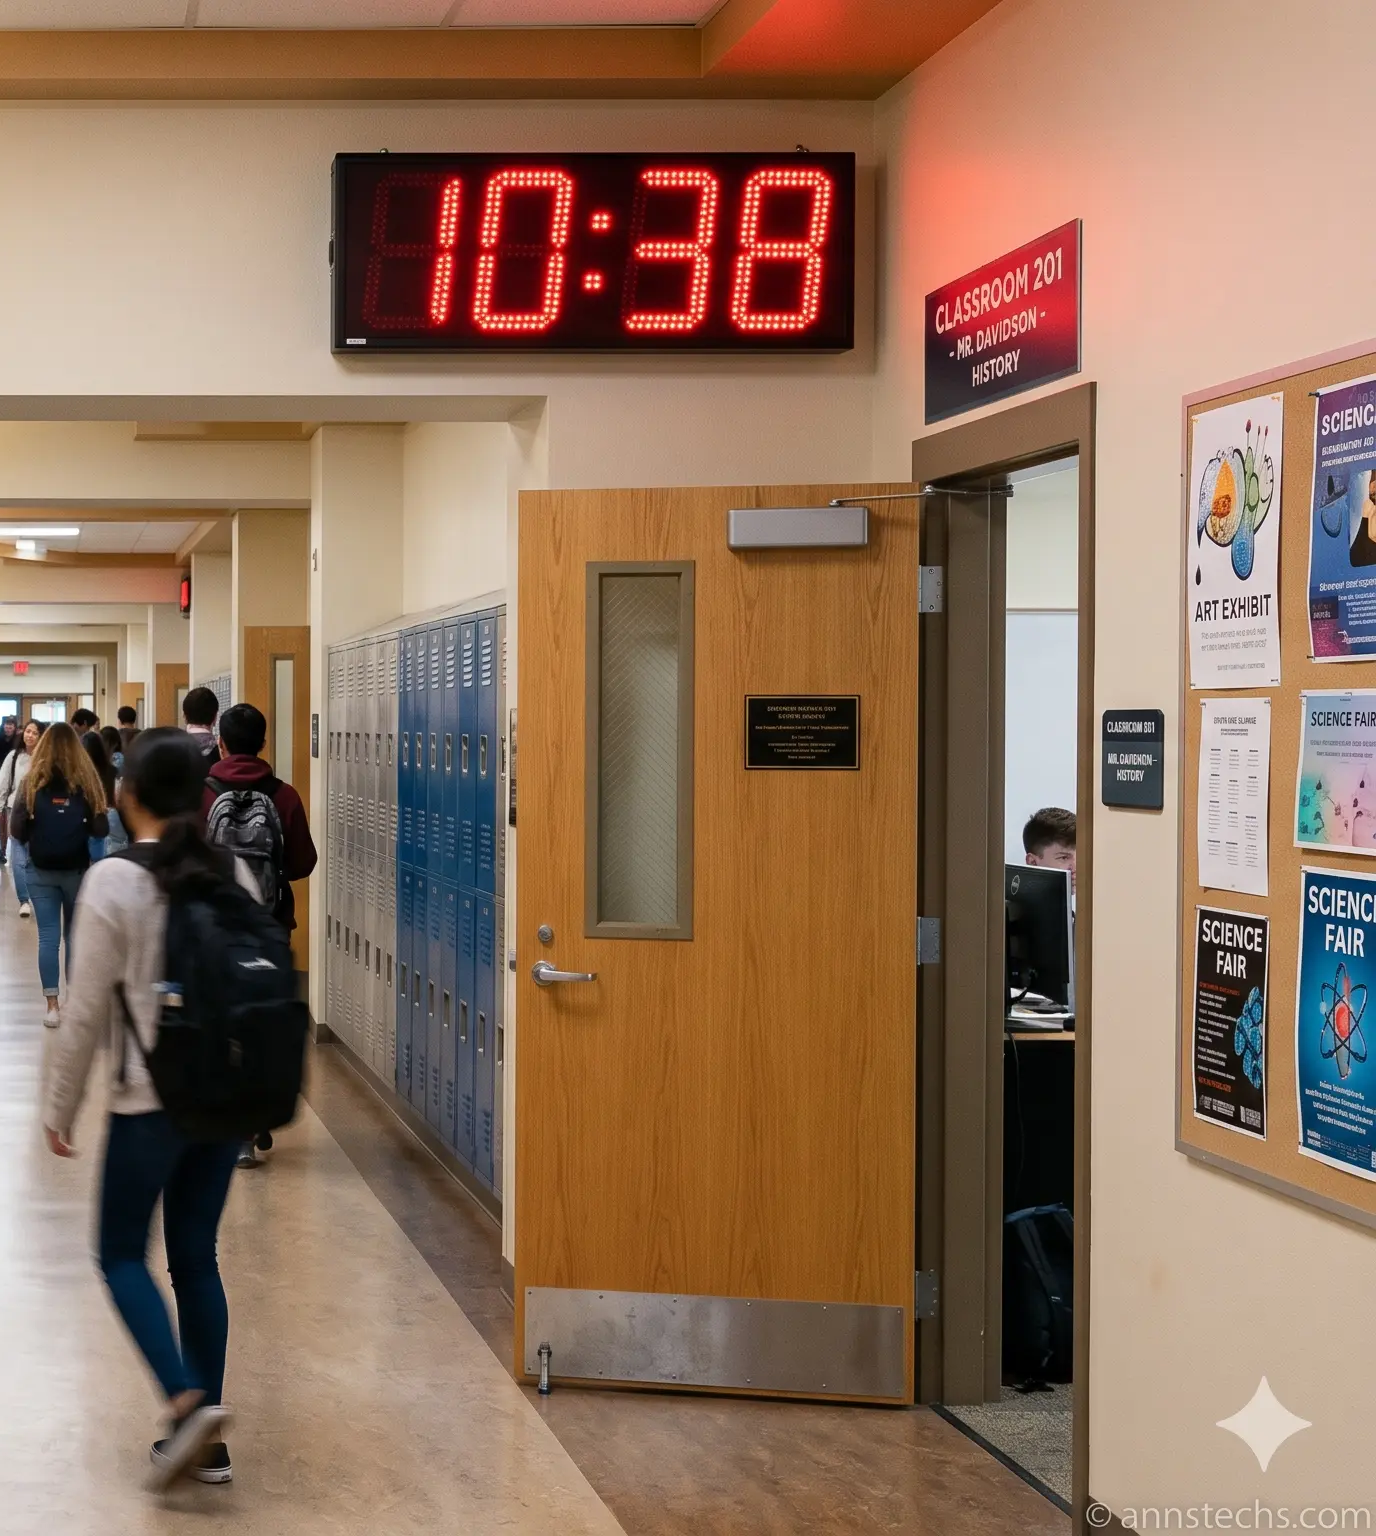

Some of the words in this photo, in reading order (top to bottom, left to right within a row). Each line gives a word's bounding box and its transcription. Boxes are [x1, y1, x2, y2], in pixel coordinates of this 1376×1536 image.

[430, 170, 832, 331] 10:38
[935, 263, 1028, 335] CLASSROOM
[1033, 247, 1063, 291] 201
[957, 335, 974, 361] MR.
[977, 306, 1037, 353] DAVIDSON
[972, 349, 1021, 387] HISTORY
[1321, 403, 1376, 436] SCIENC
[1194, 600, 1219, 622] ART
[1222, 594, 1271, 620] EXHIBIT
[1310, 711, 1352, 727] SCIENCE
[1354, 711, 1376, 727] FAIR
[1201, 918, 1263, 953] SCIENCE
[1325, 923, 1365, 958] FAIR
[1216, 950, 1247, 979] FAIR
